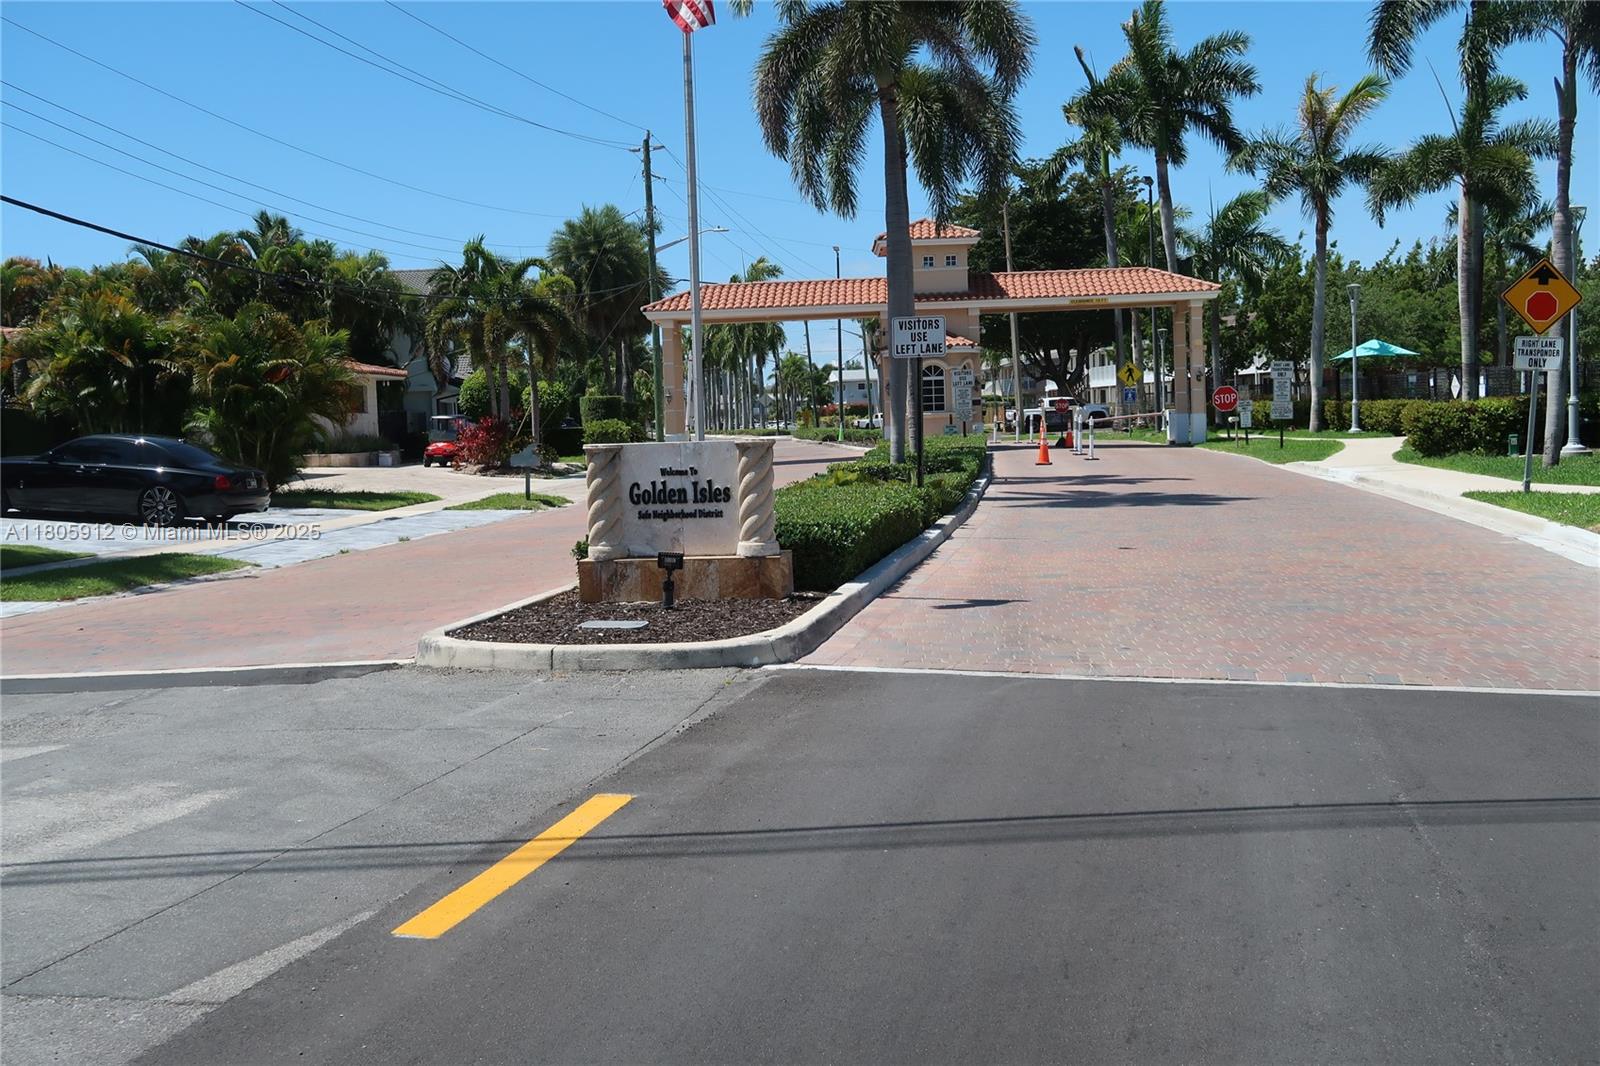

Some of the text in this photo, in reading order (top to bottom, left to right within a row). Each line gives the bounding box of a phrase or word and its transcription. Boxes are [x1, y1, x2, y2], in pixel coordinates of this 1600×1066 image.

[898, 319, 940, 331] VISITORS
[910, 332, 928, 342] USE
[895, 343, 943, 355] LEFT LANE
[1521, 340, 1539, 348] RIGHT
[1517, 348, 1560, 357] TRANSPONDER
[1528, 358, 1547, 368] ONLY
[1214, 394, 1236, 404] STOP
[660, 467, 698, 477] Welcome To
[629, 479, 731, 506] Golden Isles
[637, 508, 724, 522] Safe Neighborhood District
